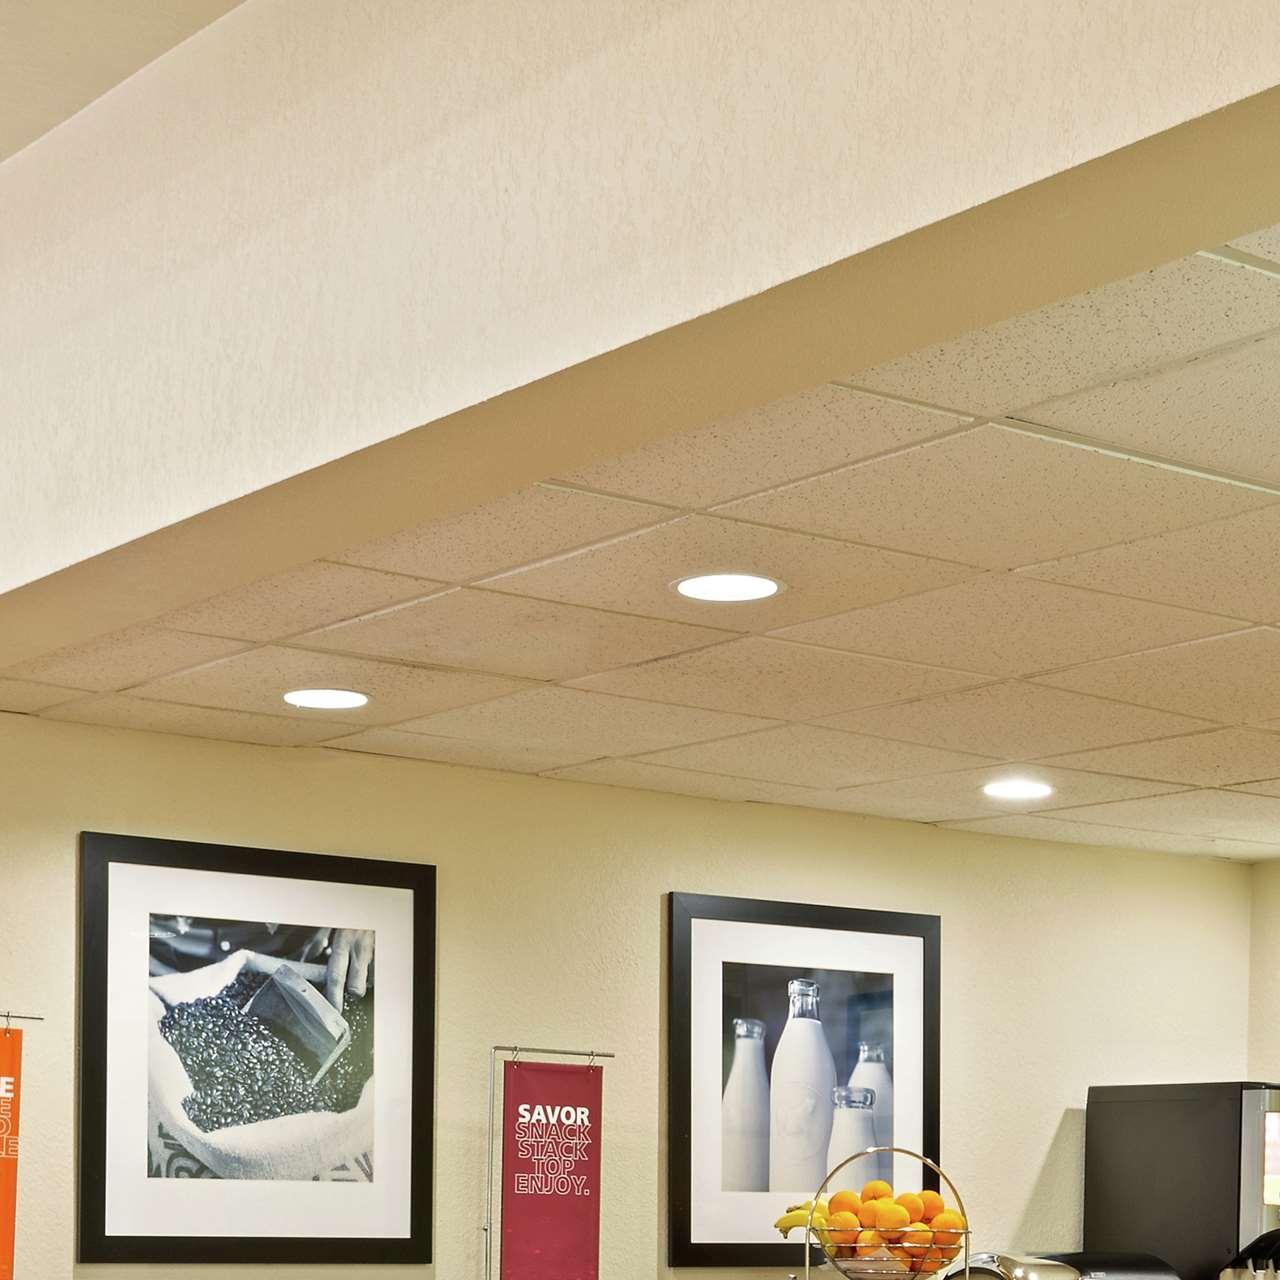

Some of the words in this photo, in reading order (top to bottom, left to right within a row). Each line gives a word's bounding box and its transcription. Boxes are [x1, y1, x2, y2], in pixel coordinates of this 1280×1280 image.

[518, 1104, 589, 1125] SAVOR
[515, 1121, 591, 1143] SNACK
[518, 1139, 588, 1160] STACK
[532, 1157, 575, 1176] TOP
[515, 1173, 590, 1195] ENJOY.
